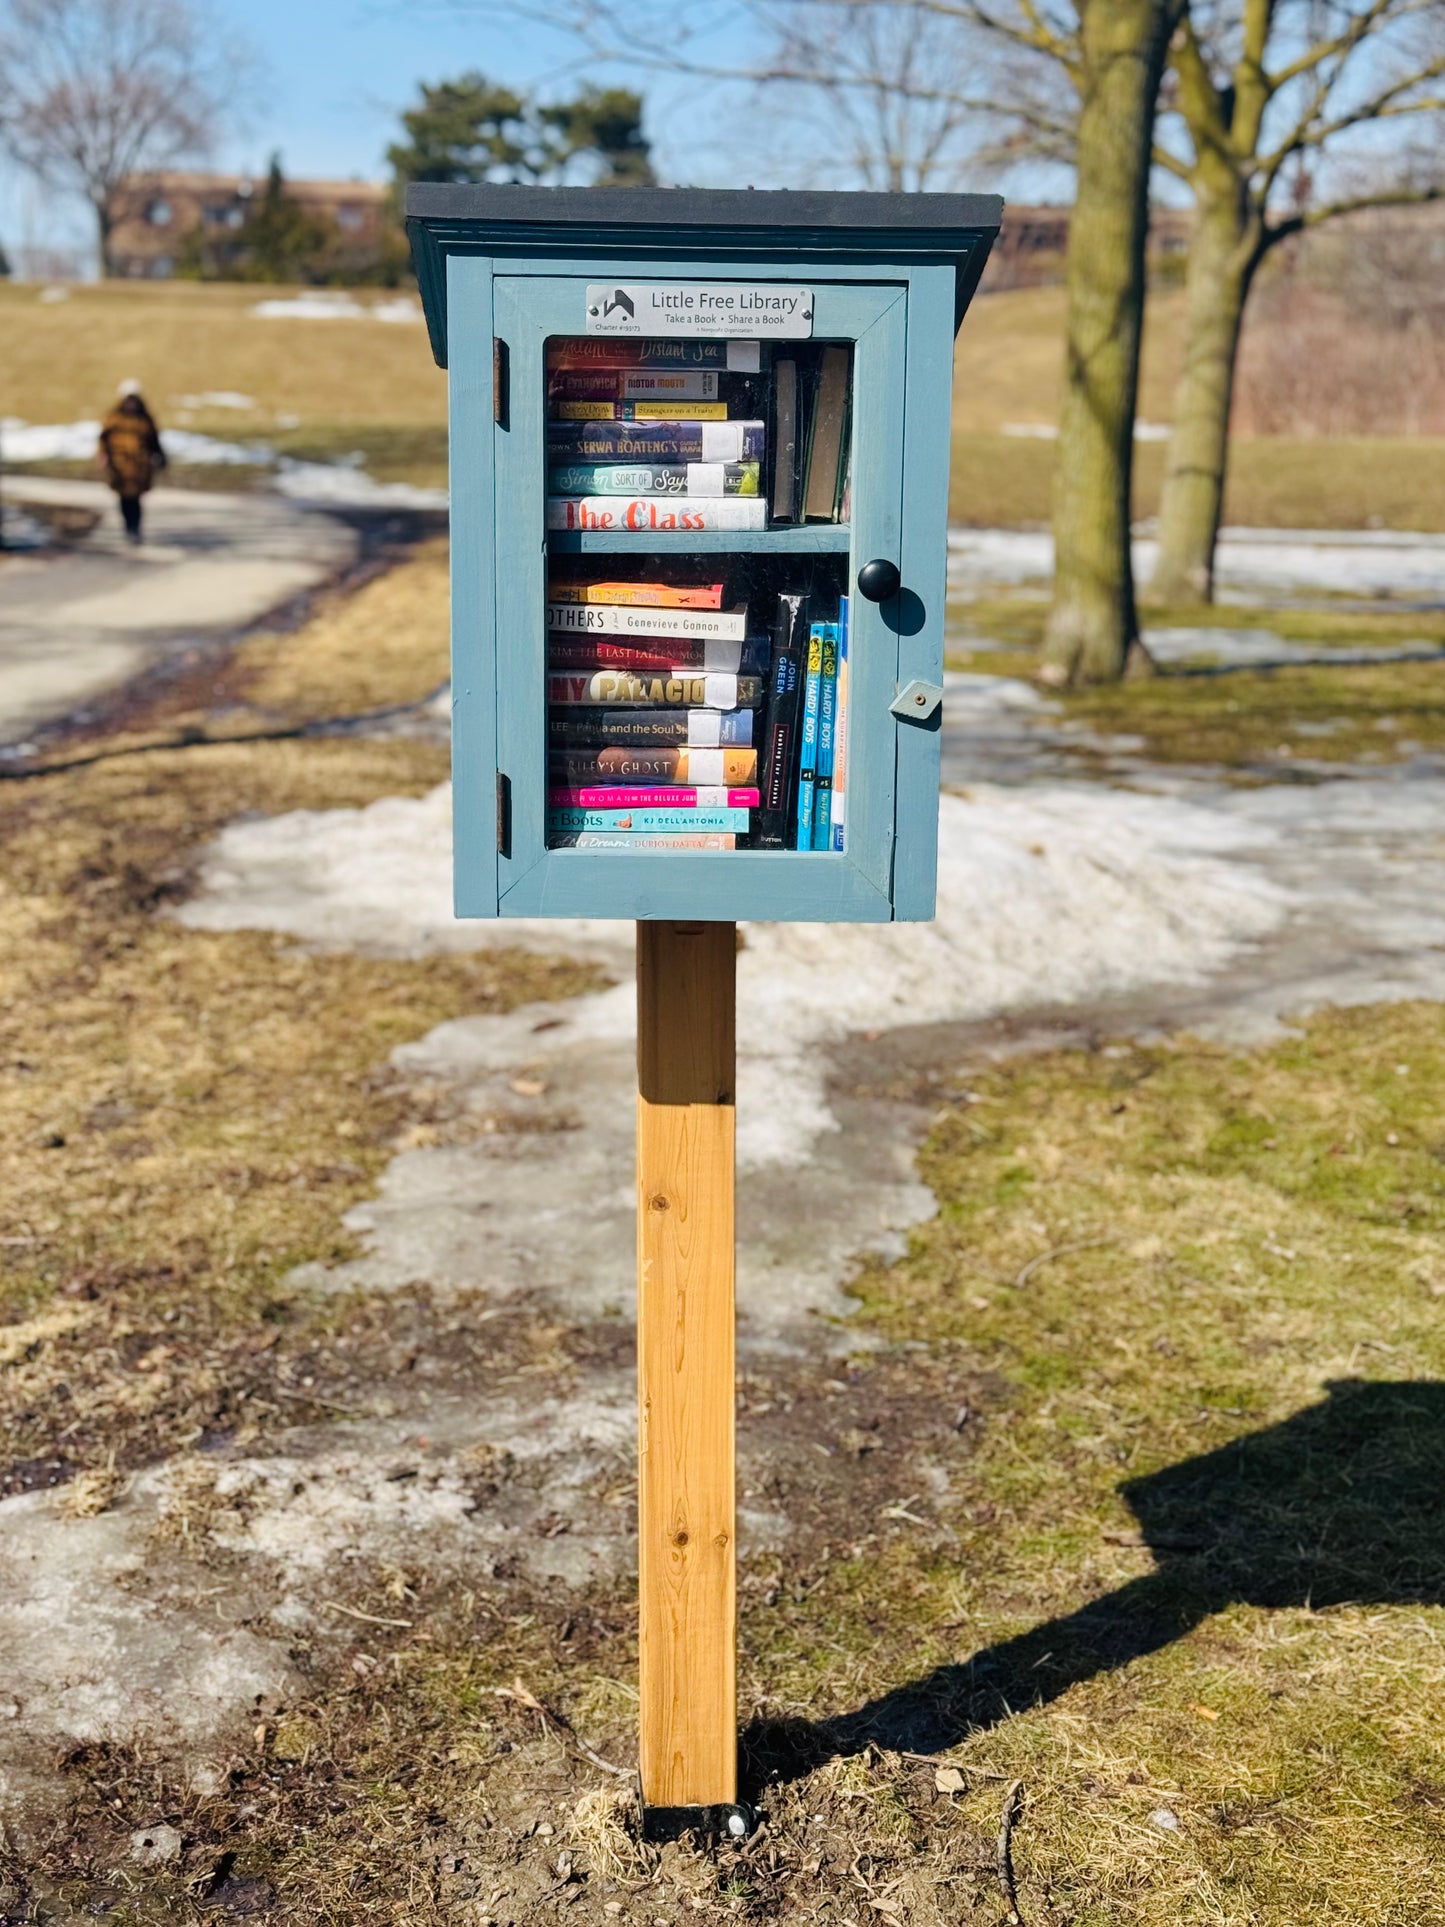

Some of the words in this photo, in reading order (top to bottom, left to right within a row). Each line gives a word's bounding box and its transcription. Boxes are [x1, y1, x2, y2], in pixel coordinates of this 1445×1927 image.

[652, 292, 694, 308] Little
[699, 293, 734, 309] Free
[740, 293, 798, 314] Library
[595, 323, 618, 331] Charter
[665, 314, 685, 324] Take
[687, 316, 693, 324] a
[694, 314, 716, 324] Book
[728, 314, 753, 324] Share
[756, 316, 762, 325] a
[763, 315, 785, 325] Book
[693, 341, 718, 361] Sea
[638, 404, 671, 415] Strangers
[577, 440, 613, 454] SERWA
[617, 440, 679, 454] BOATENG'S
[560, 468, 608, 491] Simon
[615, 472, 637, 486] SORT
[638, 473, 649, 485] OF
[560, 500, 618, 529] The
[626, 500, 706, 530] Class
[627, 616, 678, 630] Genevieve
[683, 620, 719, 632] Gannon
[605, 648, 633, 658] LAST
[635, 648, 674, 660] FALLEN
[776, 656, 788, 694] GREEN
[786, 660, 797, 692] JOHN
[806, 679, 818, 717] HARDY
[822, 683, 835, 721] HARDY
[610, 724, 631, 733] and
[633, 724, 650, 733] the
[652, 724, 674, 734] Soul
[804, 716, 816, 744] BOYS
[821, 722, 834, 750] BOYS
[568, 760, 614, 773] RILEY'S
[620, 761, 671, 773] GHOST
[561, 813, 603, 826] Boots
[658, 817, 725, 825] DELL'ANTONIA
[588, 836, 631, 848] Dreams
